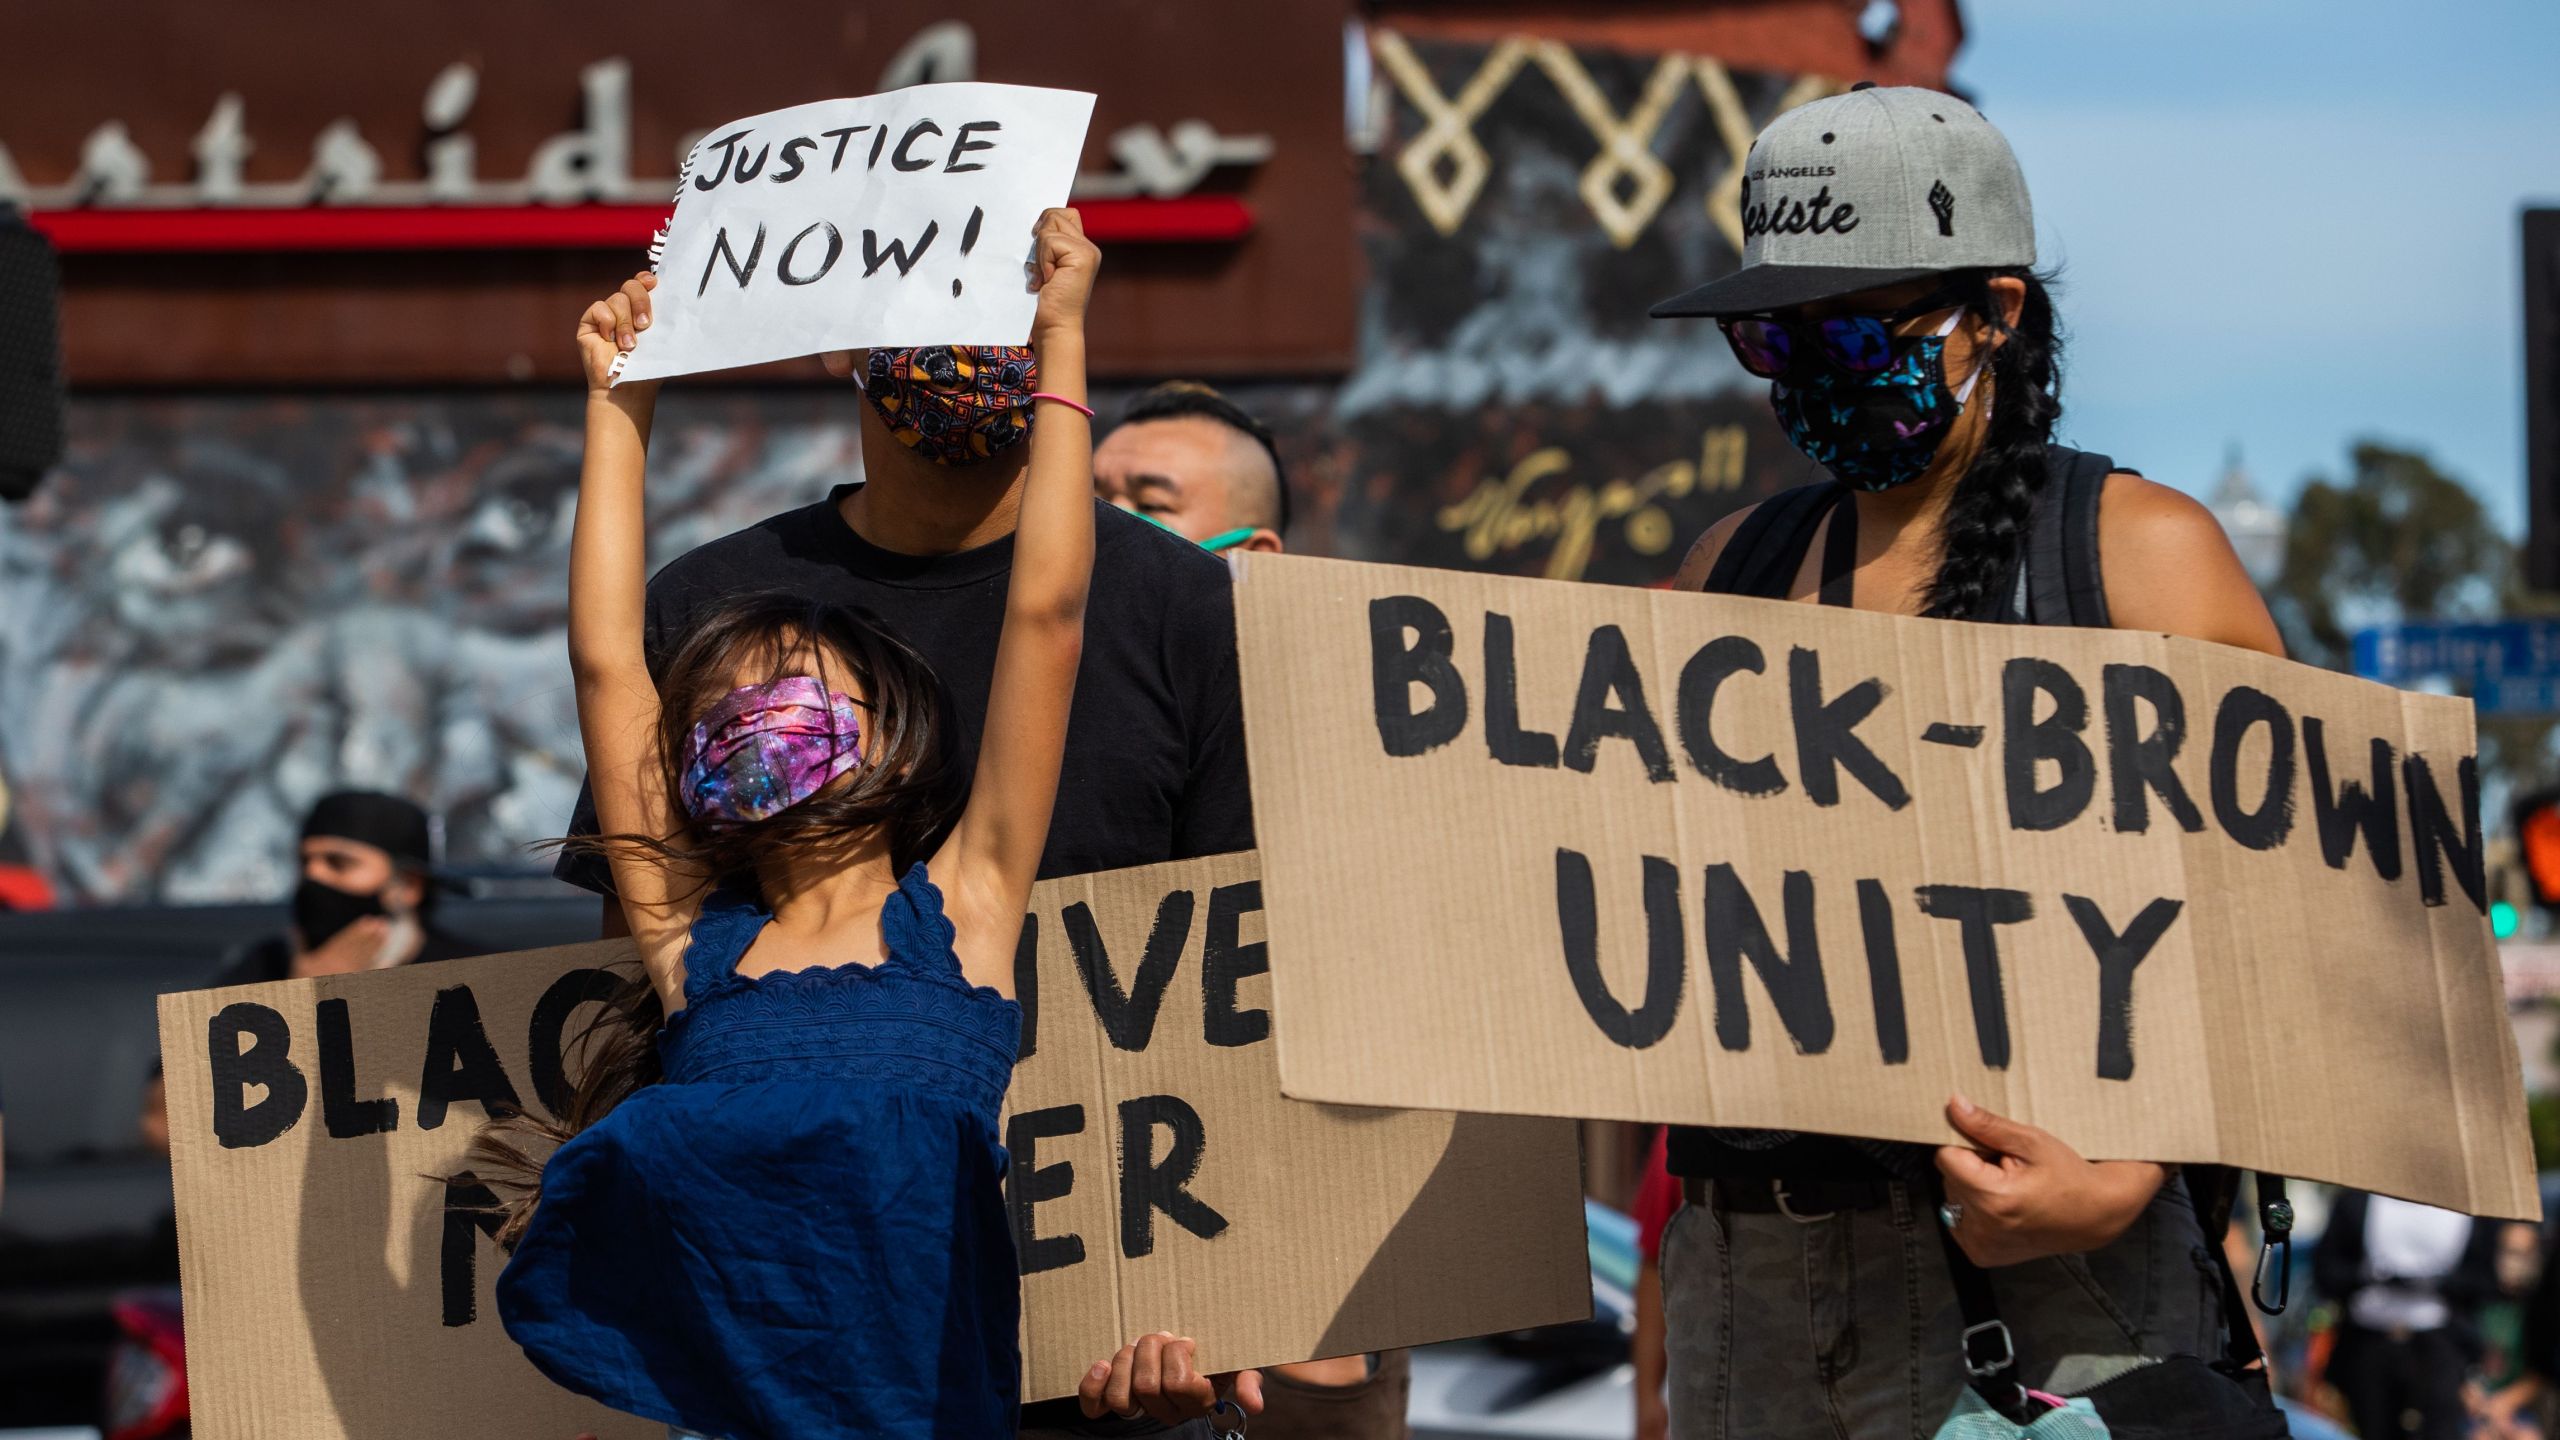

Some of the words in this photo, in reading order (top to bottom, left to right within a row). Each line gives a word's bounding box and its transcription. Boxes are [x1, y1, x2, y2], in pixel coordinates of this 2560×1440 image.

[695, 117, 1002, 192] JUSTICE
[1768, 166, 1836, 179] ANGELES
[697, 205, 984, 300] NOW!
[1369, 596, 2487, 916] BLACK-BROWN
[208, 968, 640, 1149] BLAC
[1012, 880, 1274, 1062] IVE
[1556, 847, 2185, 1081] UNITY
